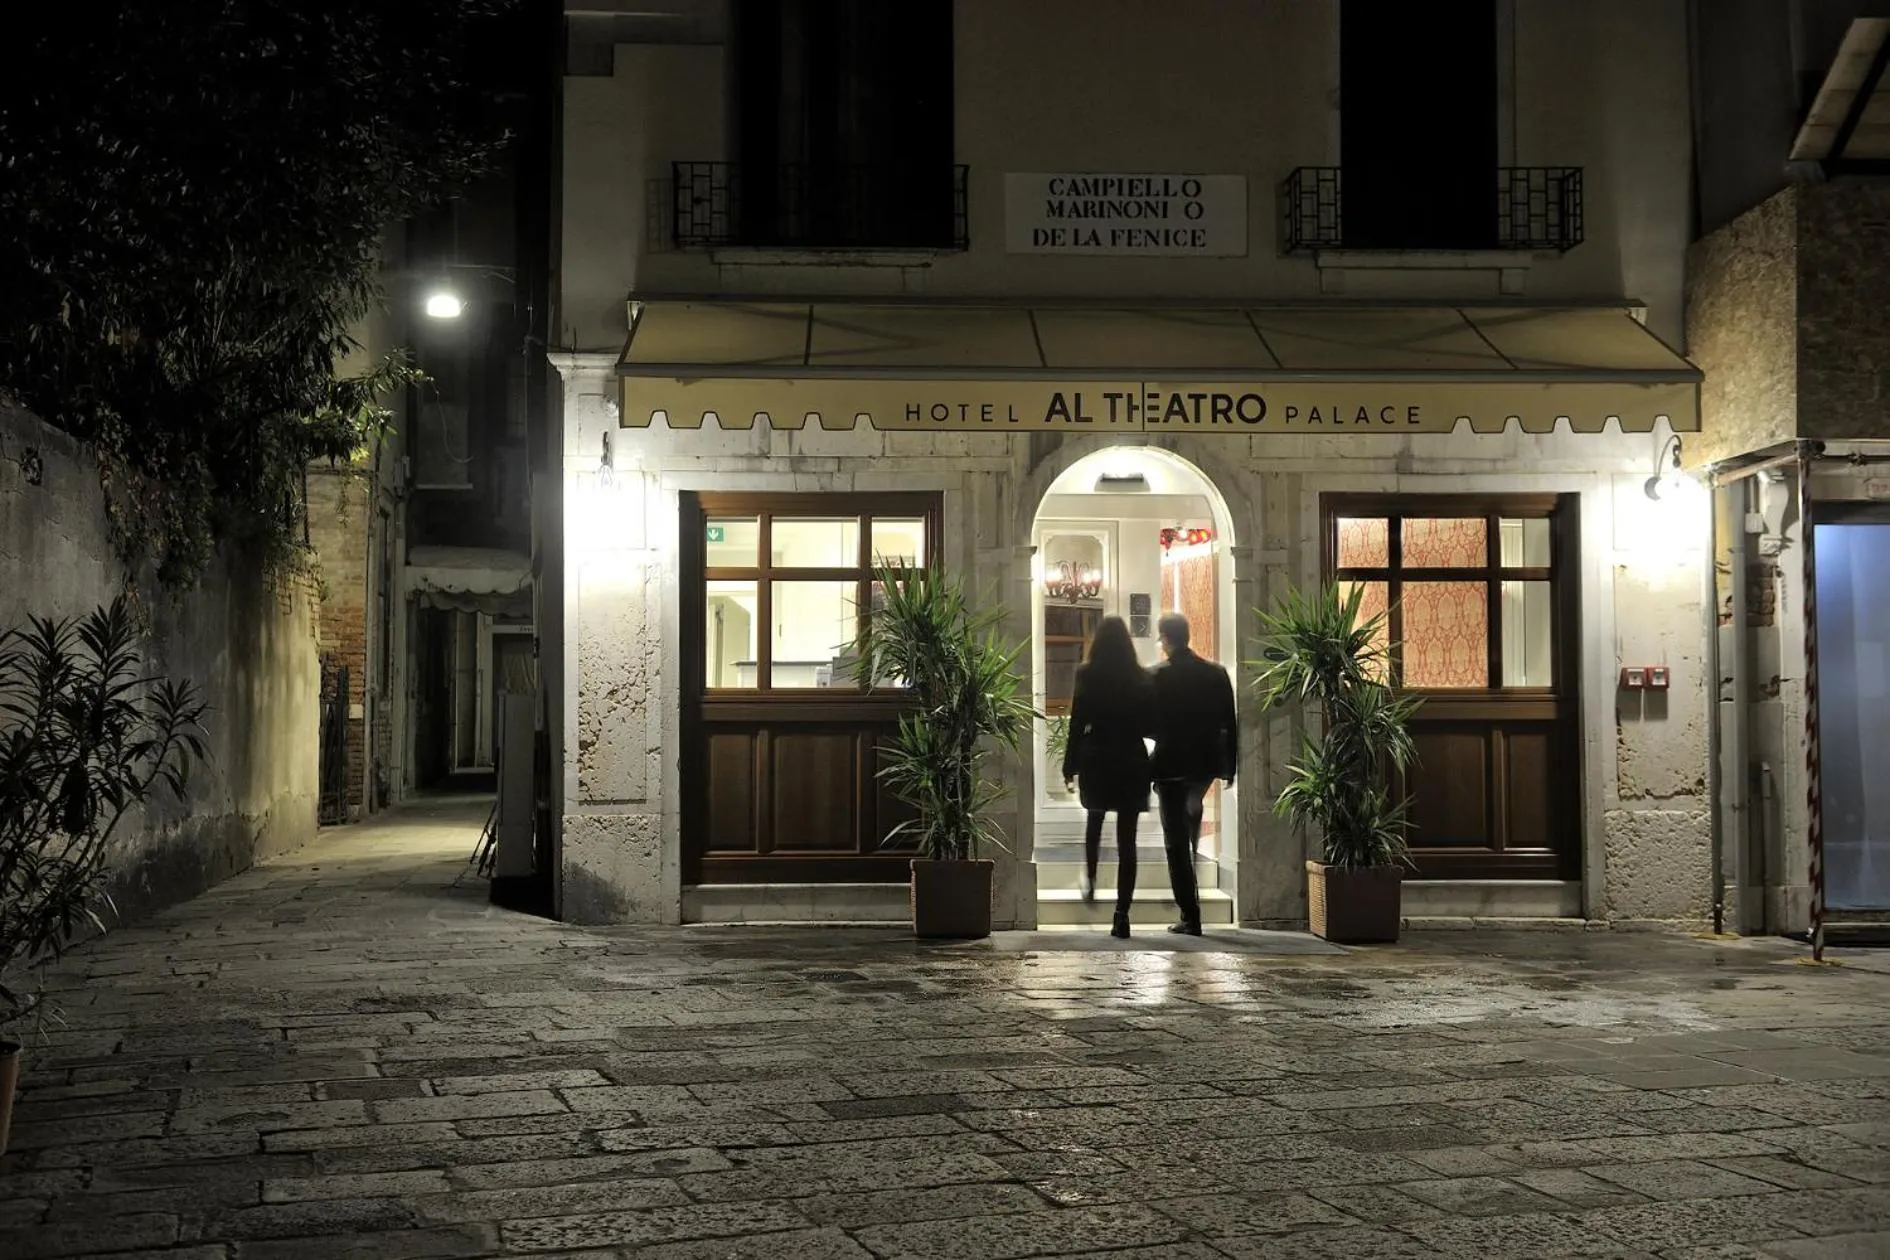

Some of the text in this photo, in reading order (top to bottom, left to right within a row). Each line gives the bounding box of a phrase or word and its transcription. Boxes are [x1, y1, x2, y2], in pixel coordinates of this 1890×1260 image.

[1048, 177, 1202, 199] CAMPIELLO
[1046, 199, 1205, 221] MARINONI O
[1032, 227, 1207, 248] DE LA FENICE
[905, 392, 1421, 425] HOTEL AL THEATRO PALACE
